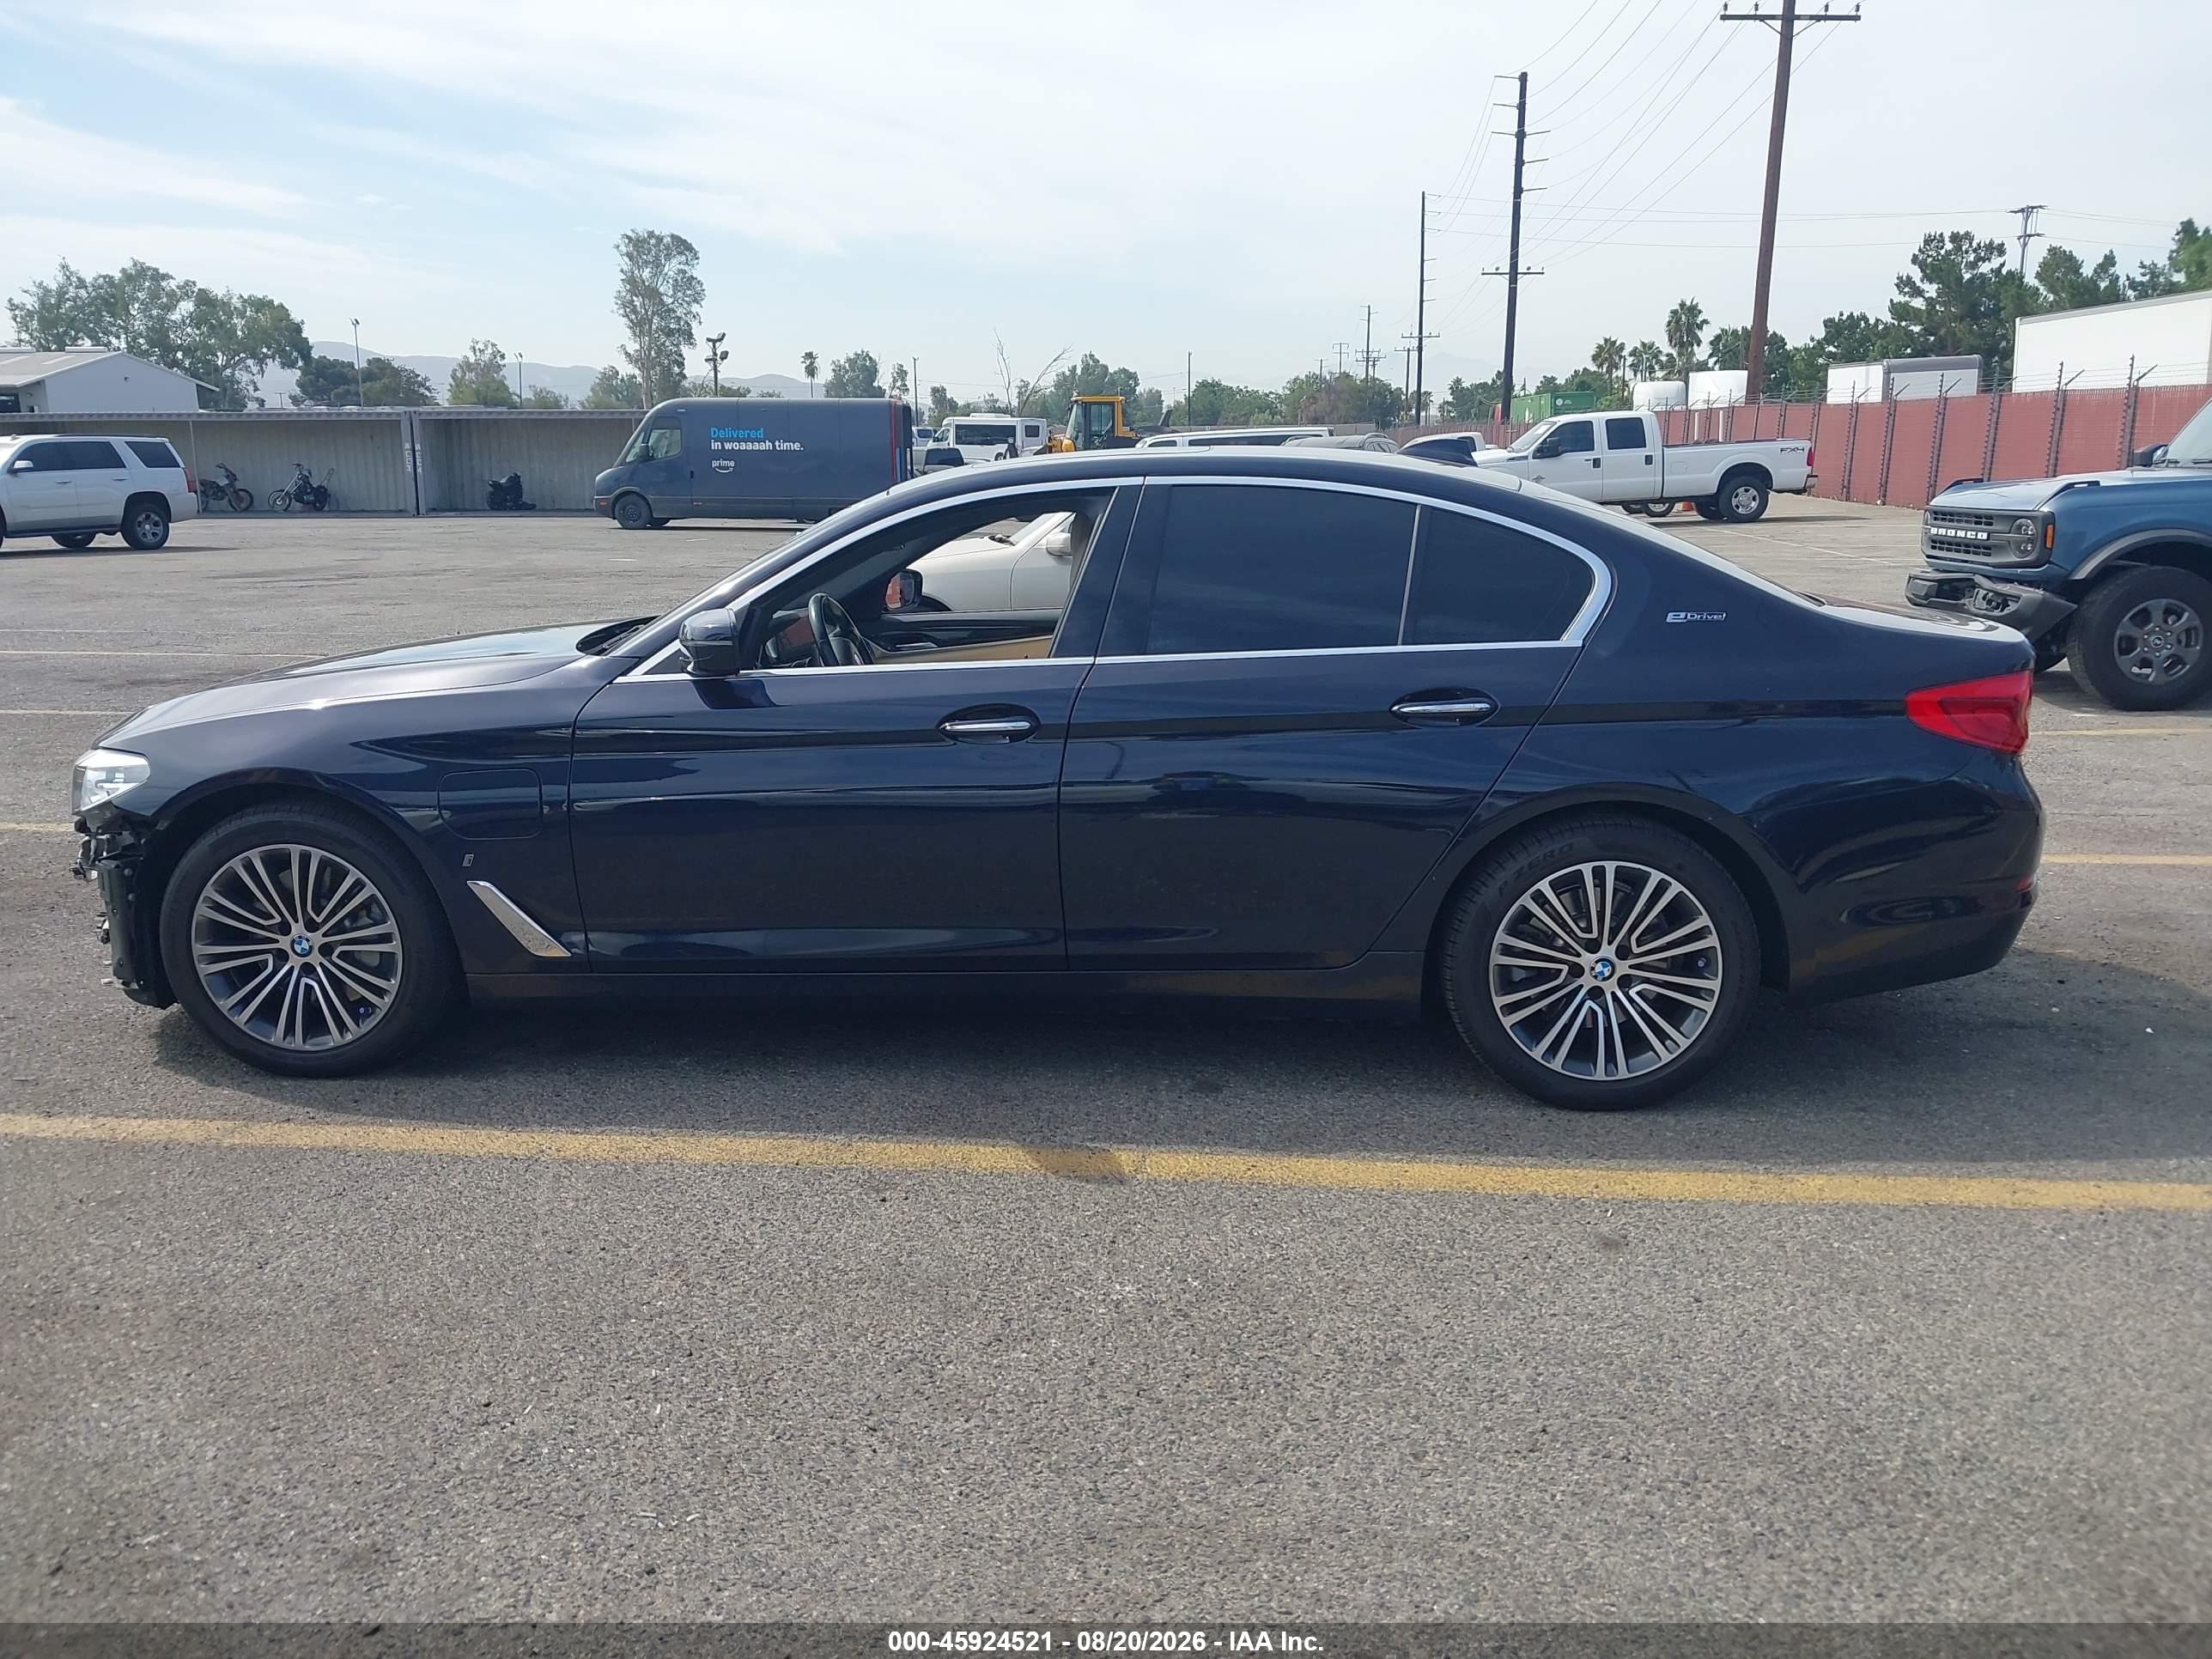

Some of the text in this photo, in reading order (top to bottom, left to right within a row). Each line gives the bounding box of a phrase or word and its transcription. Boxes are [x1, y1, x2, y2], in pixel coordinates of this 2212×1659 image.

[710, 427, 764, 439] Delivered
[711, 439, 804, 451] in woaaaah time.
[711, 459, 735, 468] prime
[1930, 527, 1988, 540] BRONCO
